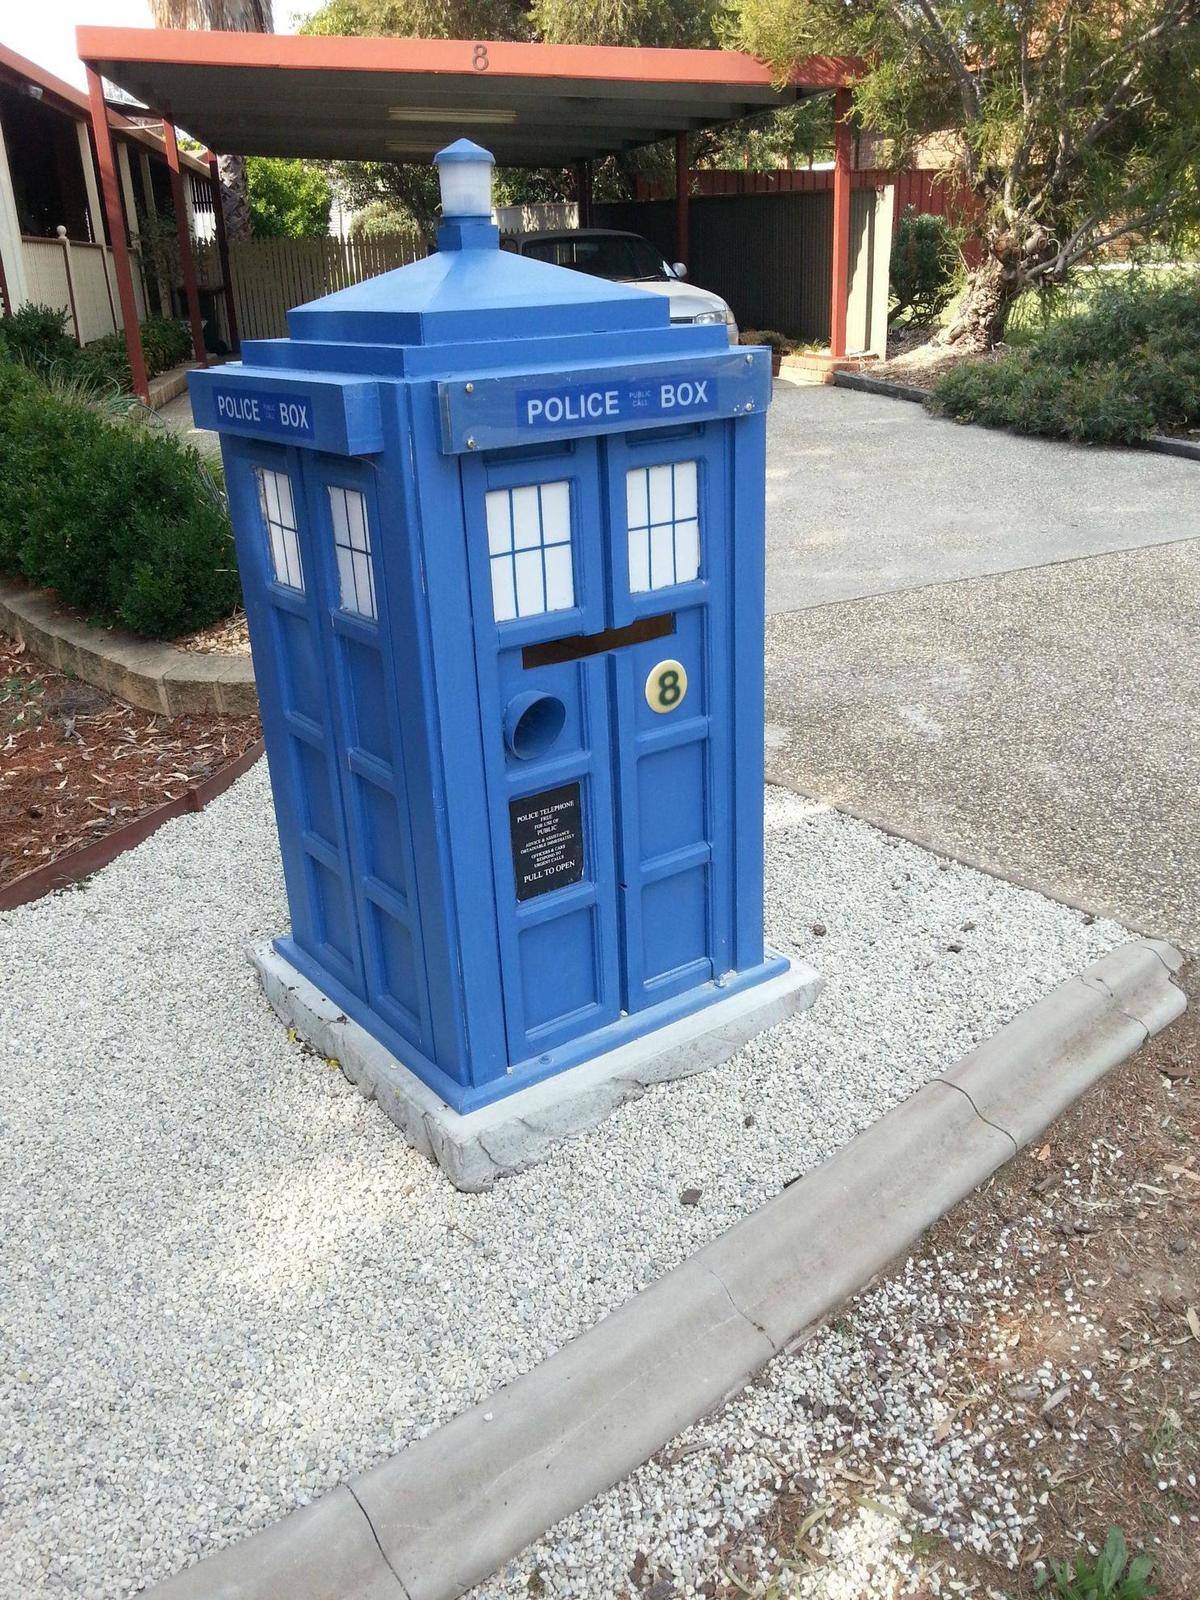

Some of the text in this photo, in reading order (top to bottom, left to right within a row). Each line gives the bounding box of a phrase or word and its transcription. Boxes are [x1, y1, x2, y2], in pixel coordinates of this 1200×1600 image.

[473, 44, 489, 71] 8
[527, 380, 708, 425] POLICE BOX
[629, 390, 651, 399] PUBLIC
[217, 395, 260, 422] POLICE
[279, 402, 309, 429] BOX
[658, 670, 681, 706] 8
[517, 800, 575, 823] POLICE TELEPHONE
[536, 825, 557, 836] PUBLIC
[523, 859, 576, 883] PULL TO OPEN
